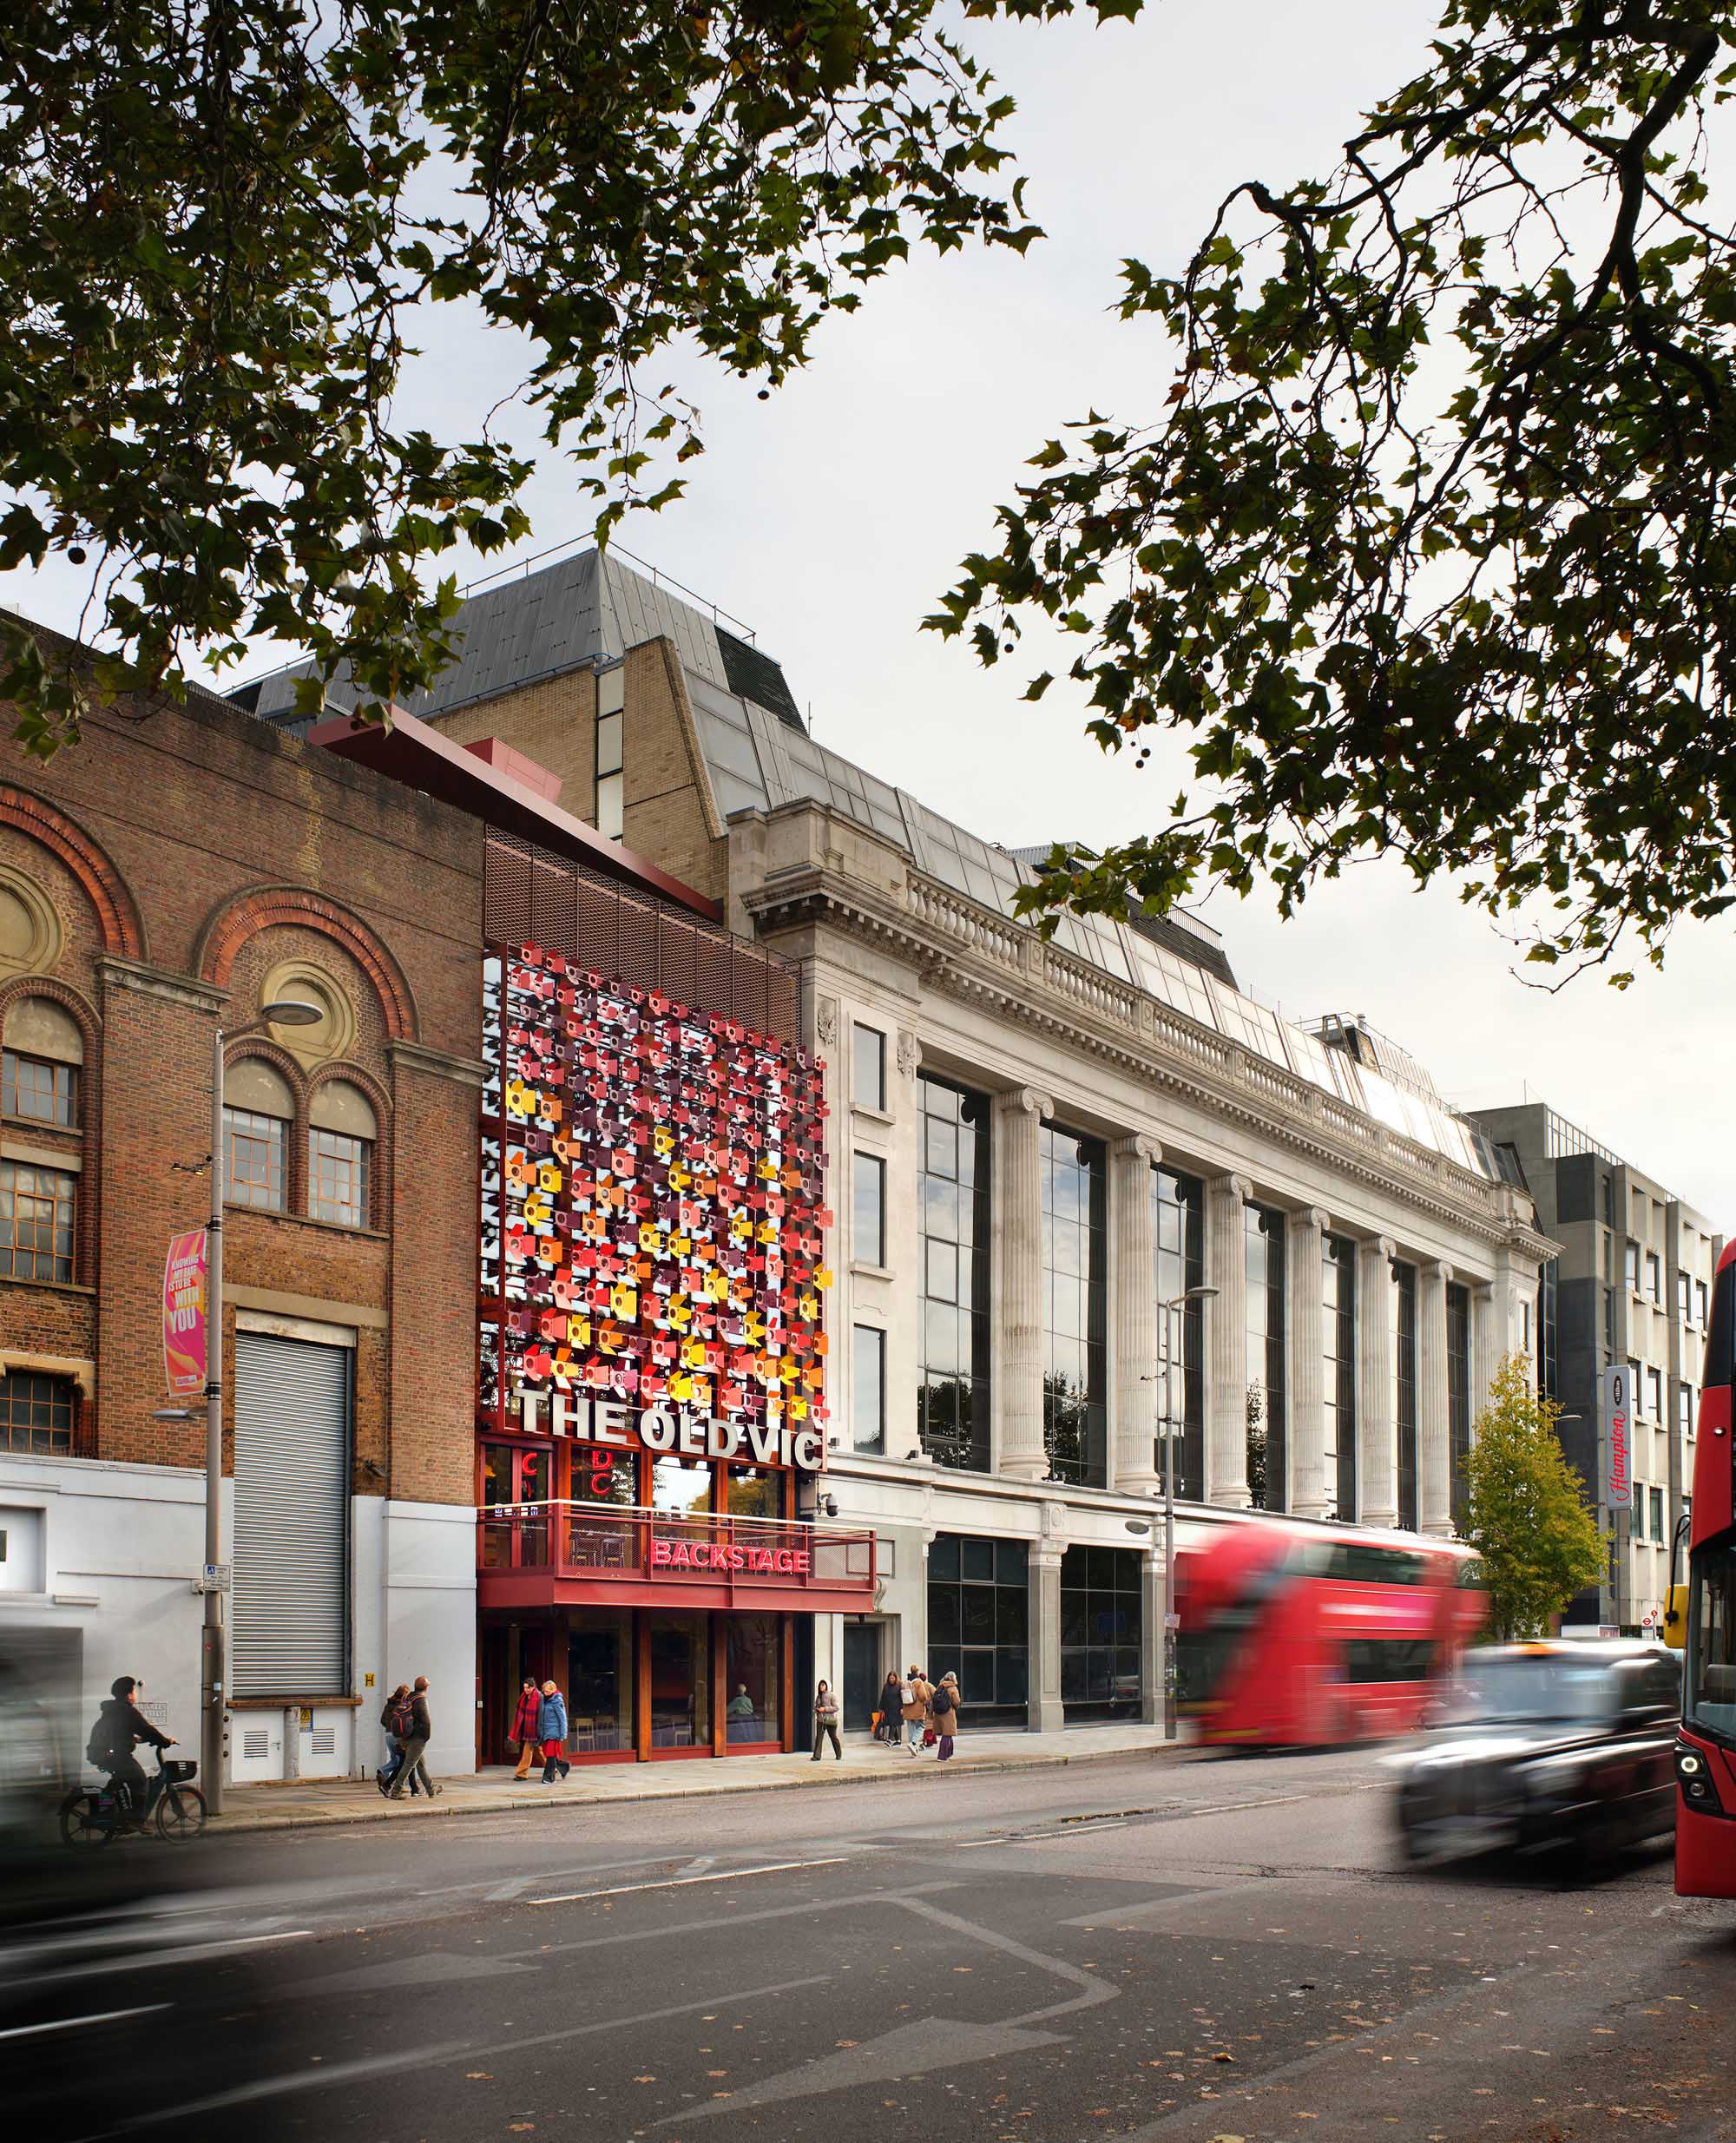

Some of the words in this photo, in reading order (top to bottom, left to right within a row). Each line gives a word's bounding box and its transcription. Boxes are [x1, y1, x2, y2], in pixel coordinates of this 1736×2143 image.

[172, 1254, 199, 1271] KNOWING
[168, 1281, 175, 1292] IS
[175, 1279, 183, 1291] TO
[183, 1277, 192, 1287] BE
[175, 1286, 200, 1307] WITH
[169, 1305, 197, 1334] YOU
[513, 1389, 628, 1444] THE
[639, 1407, 739, 1459] OLD
[746, 1423, 823, 1470] VIC
[1610, 1410, 1629, 1501] Hampton
[652, 1539, 811, 1574] BACKSTAGE
[365, 1673, 375, 1687] H
